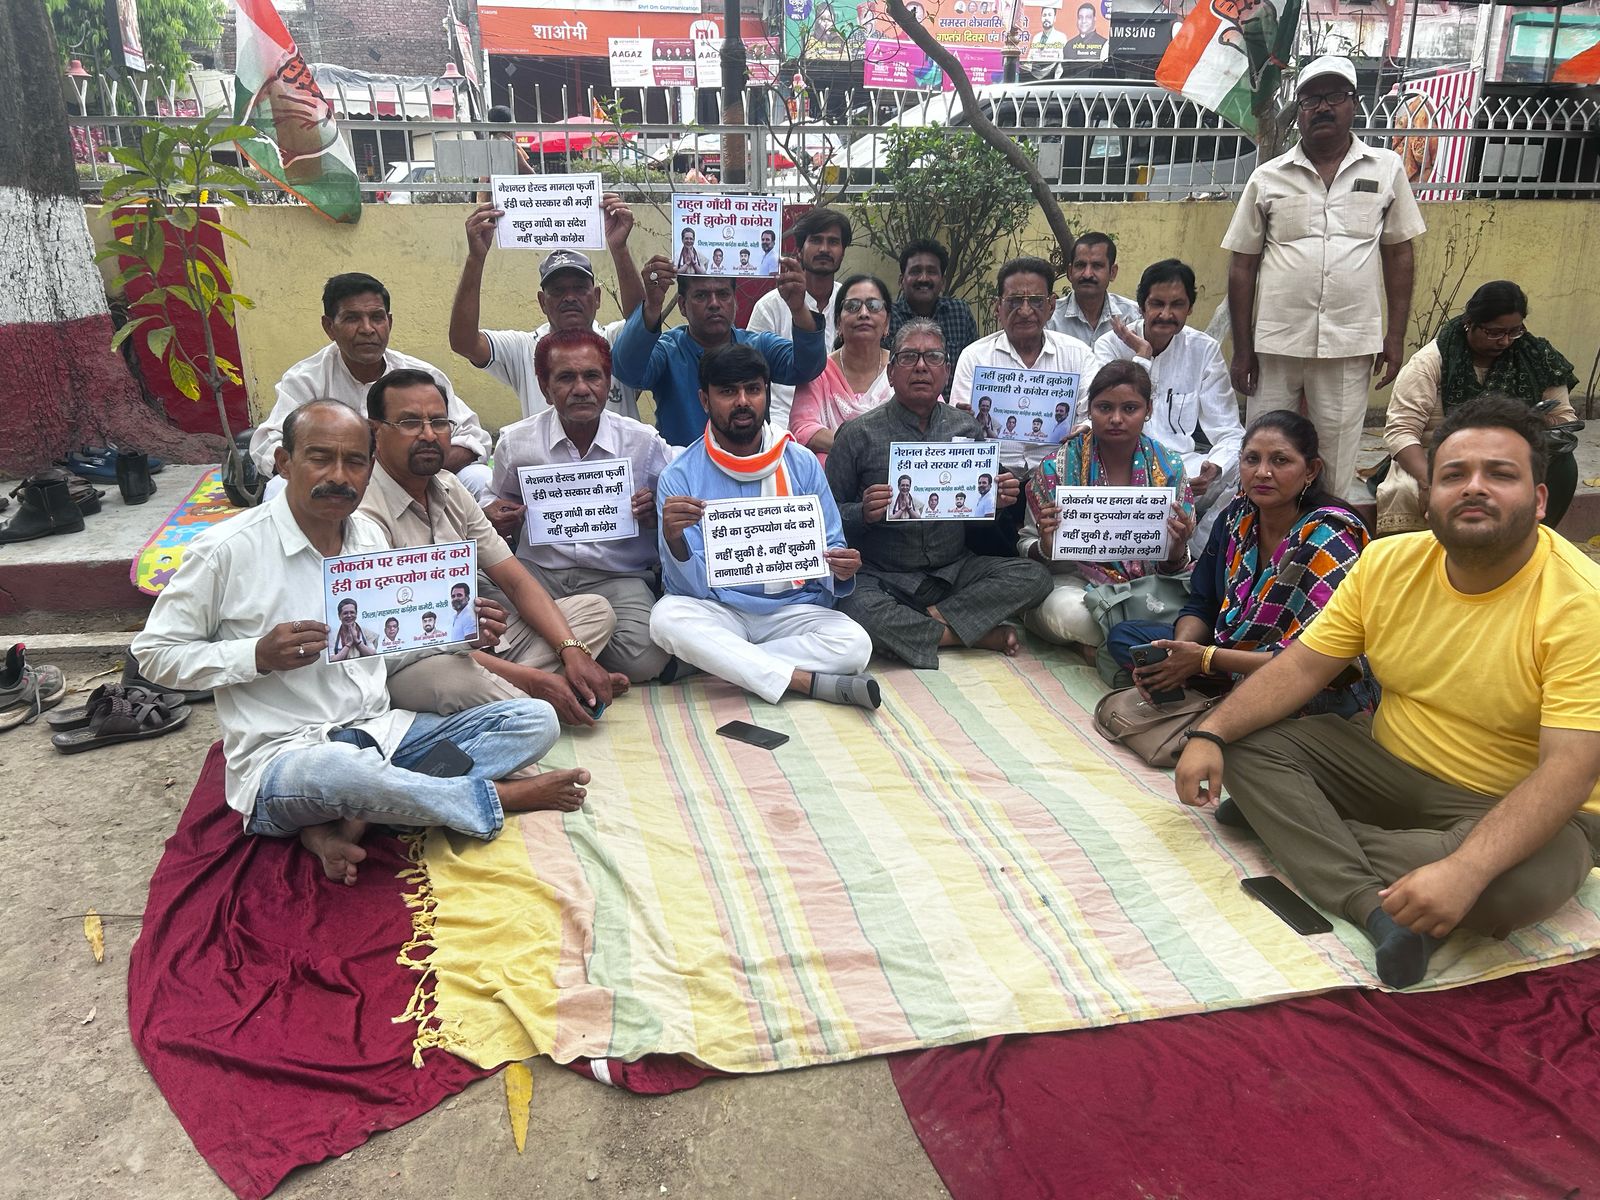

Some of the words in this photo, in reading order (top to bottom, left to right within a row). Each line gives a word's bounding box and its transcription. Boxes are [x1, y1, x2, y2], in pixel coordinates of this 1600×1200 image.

[531, 20, 588, 40] शाओमी
[940, 18, 966, 28] समस्त
[964, 31, 985, 42] दिवस
[498, 183, 525, 192] नेशनल
[528, 182, 547, 192] हेरल्ड
[550, 183, 574, 191] मामला
[576, 180, 595, 192] फ़र्जी
[504, 198, 517, 209] ईडी
[520, 198, 533, 208] चले
[535, 199, 560, 207] सरकार
[563, 196, 573, 206] की
[575, 196, 592, 208] मर्ज़ी
[677, 199, 703, 212] राहुल
[707, 198, 731, 210] गाँधी
[735, 201, 748, 211] का
[752, 200, 777, 212] संदेश
[513, 221, 532, 232] राहुल
[535, 217, 552, 228] गांधी
[567, 217, 586, 227] संदेश
[682, 213, 701, 225] नहीं
[704, 214, 737, 228] झुकेगी
[740, 215, 773, 227] कांग्रेस
[517, 233, 533, 243] नहीं
[534, 233, 558, 245] झुकेगी
[560, 233, 584, 243] कांग्रेस
[981, 371, 996, 380] नहीं
[997, 372, 1016, 383] झुकी
[1018, 373, 1027, 383] है,
[1030, 374, 1045, 384] नहीं
[1046, 375, 1073, 386] झुकेगी
[976, 384, 1011, 393] तानाशाही
[1014, 385, 1021, 394] से
[1023, 386, 1049, 397] कांग्रेस
[1051, 389, 1074, 398] लड़ेगी
[894, 447, 922, 456] नेशनल
[925, 447, 946, 456] हेरल्ड
[948, 448, 974, 456] मामला
[977, 446, 996, 455] फर्जी
[897, 460, 911, 471] ईडी
[914, 460, 928, 469] चले
[931, 461, 958, 469] सरकार
[961, 459, 972, 468] की
[975, 458, 992, 468] मर्जी
[525, 475, 553, 485] नेशनल
[555, 472, 575, 483] हेरल्ड
[577, 471, 604, 480] मामला
[606, 465, 625, 479] फ़र्जी
[532, 488, 547, 501] ईडी
[549, 488, 563, 499] चले
[564, 488, 591, 497] सरकार
[592, 484, 603, 494] की
[605, 482, 623, 495] मर्ज़ी
[1062, 494, 1093, 505] लोकतंत्र
[1096, 497, 1107, 505] पर
[1109, 497, 1133, 505] हमला
[1150, 495, 1167, 505] करो
[543, 510, 563, 523] राहुल
[564, 506, 583, 518] गांधी
[584, 508, 596, 516] का
[597, 505, 618, 516] संदेश
[708, 507, 742, 521] लोकतंत्र
[744, 508, 756, 517] पर
[758, 506, 781, 517] हमला
[798, 502, 813, 512] करो
[1062, 509, 1077, 520] ईडी
[1093, 510, 1131, 523] दुरुपयोग
[1147, 510, 1164, 520] करो
[547, 524, 563, 535] नहीं
[564, 522, 589, 537] झुकेगी
[591, 521, 617, 532] कांग्रेस
[712, 525, 727, 539] ईडी
[730, 527, 742, 536] का
[744, 521, 782, 539] दुरुपयोग
[799, 517, 815, 528] करो
[1062, 529, 1080, 539] नहीं
[1081, 529, 1100, 542] झुकी
[1103, 530, 1112, 540] है,
[1115, 530, 1132, 541] नहीं
[1133, 530, 1161, 543] झुकेगी
[715, 548, 733, 560] नहीं
[734, 546, 755, 562] झुकी
[757, 545, 767, 557] है,
[769, 543, 787, 555] नहीं
[788, 539, 815, 557] झुकेगी
[1060, 545, 1096, 555] तानाशाही
[1099, 545, 1107, 554] से
[1108, 546, 1135, 555] कांग्रेस
[1137, 546, 1161, 556] लड़ेगी
[330, 557, 373, 574] लोकतंत्र
[378, 557, 393, 567] पर
[397, 552, 427, 565] हमला
[431, 548, 446, 561] बंद
[450, 545, 471, 559] करो
[714, 563, 753, 578] तानाशाही
[756, 563, 763, 574] से
[766, 560, 792, 573] कांग्रेस
[794, 556, 819, 571] लड़ेगी
[331, 578, 352, 596] ईडी
[355, 579, 371, 590] का
[431, 567, 445, 579] बंद
[449, 563, 470, 577] करो
